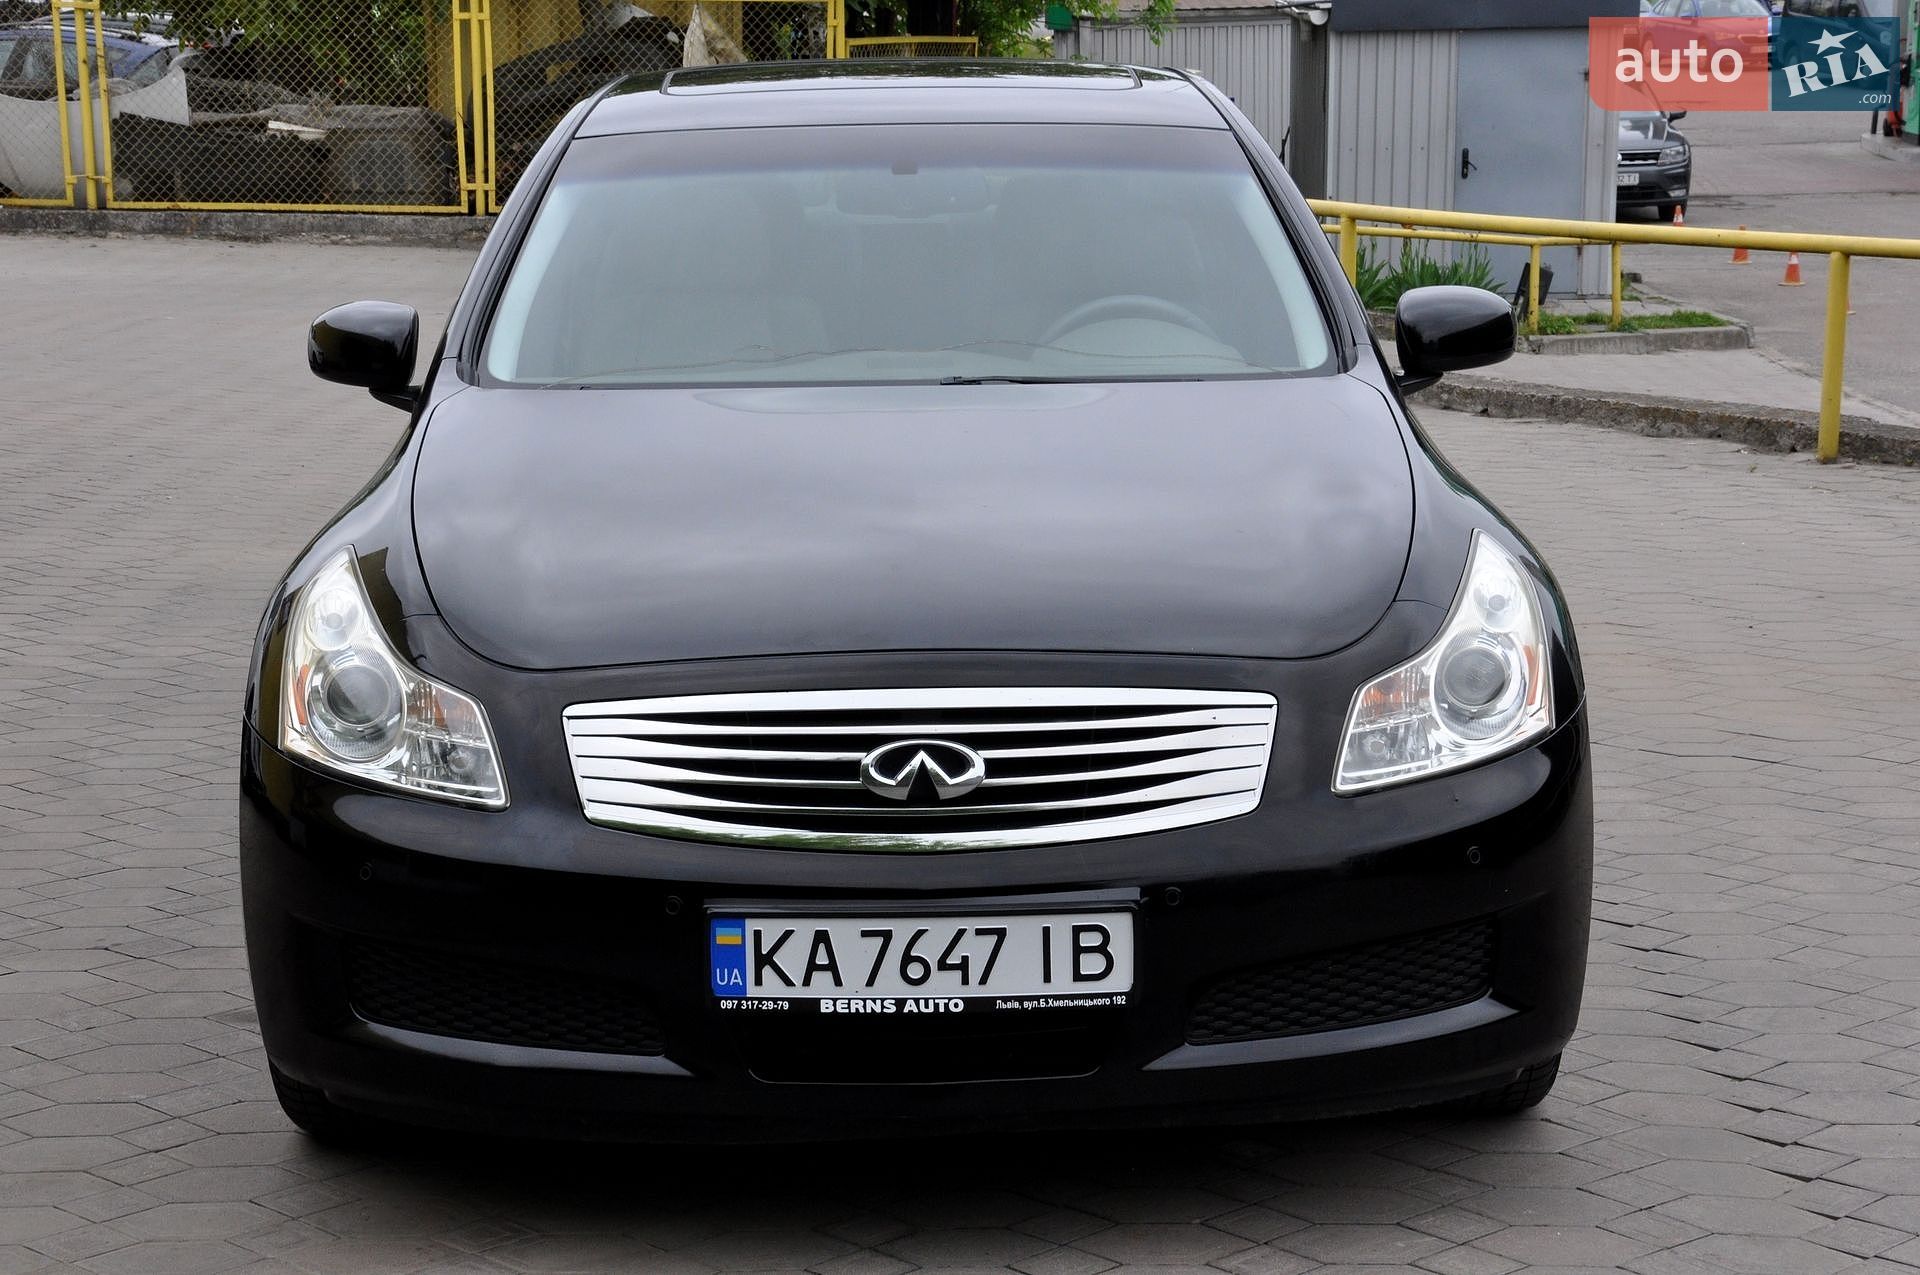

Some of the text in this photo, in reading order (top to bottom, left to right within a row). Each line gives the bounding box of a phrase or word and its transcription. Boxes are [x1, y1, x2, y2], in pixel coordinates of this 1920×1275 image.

[753, 923, 1116, 988] KA 7647 IB
[716, 967, 743, 987] UA
[720, 1000, 789, 1010] 097 317-29-79
[820, 998, 965, 1013] BERNS AUTO
[1112, 995, 1127, 1005] 192
